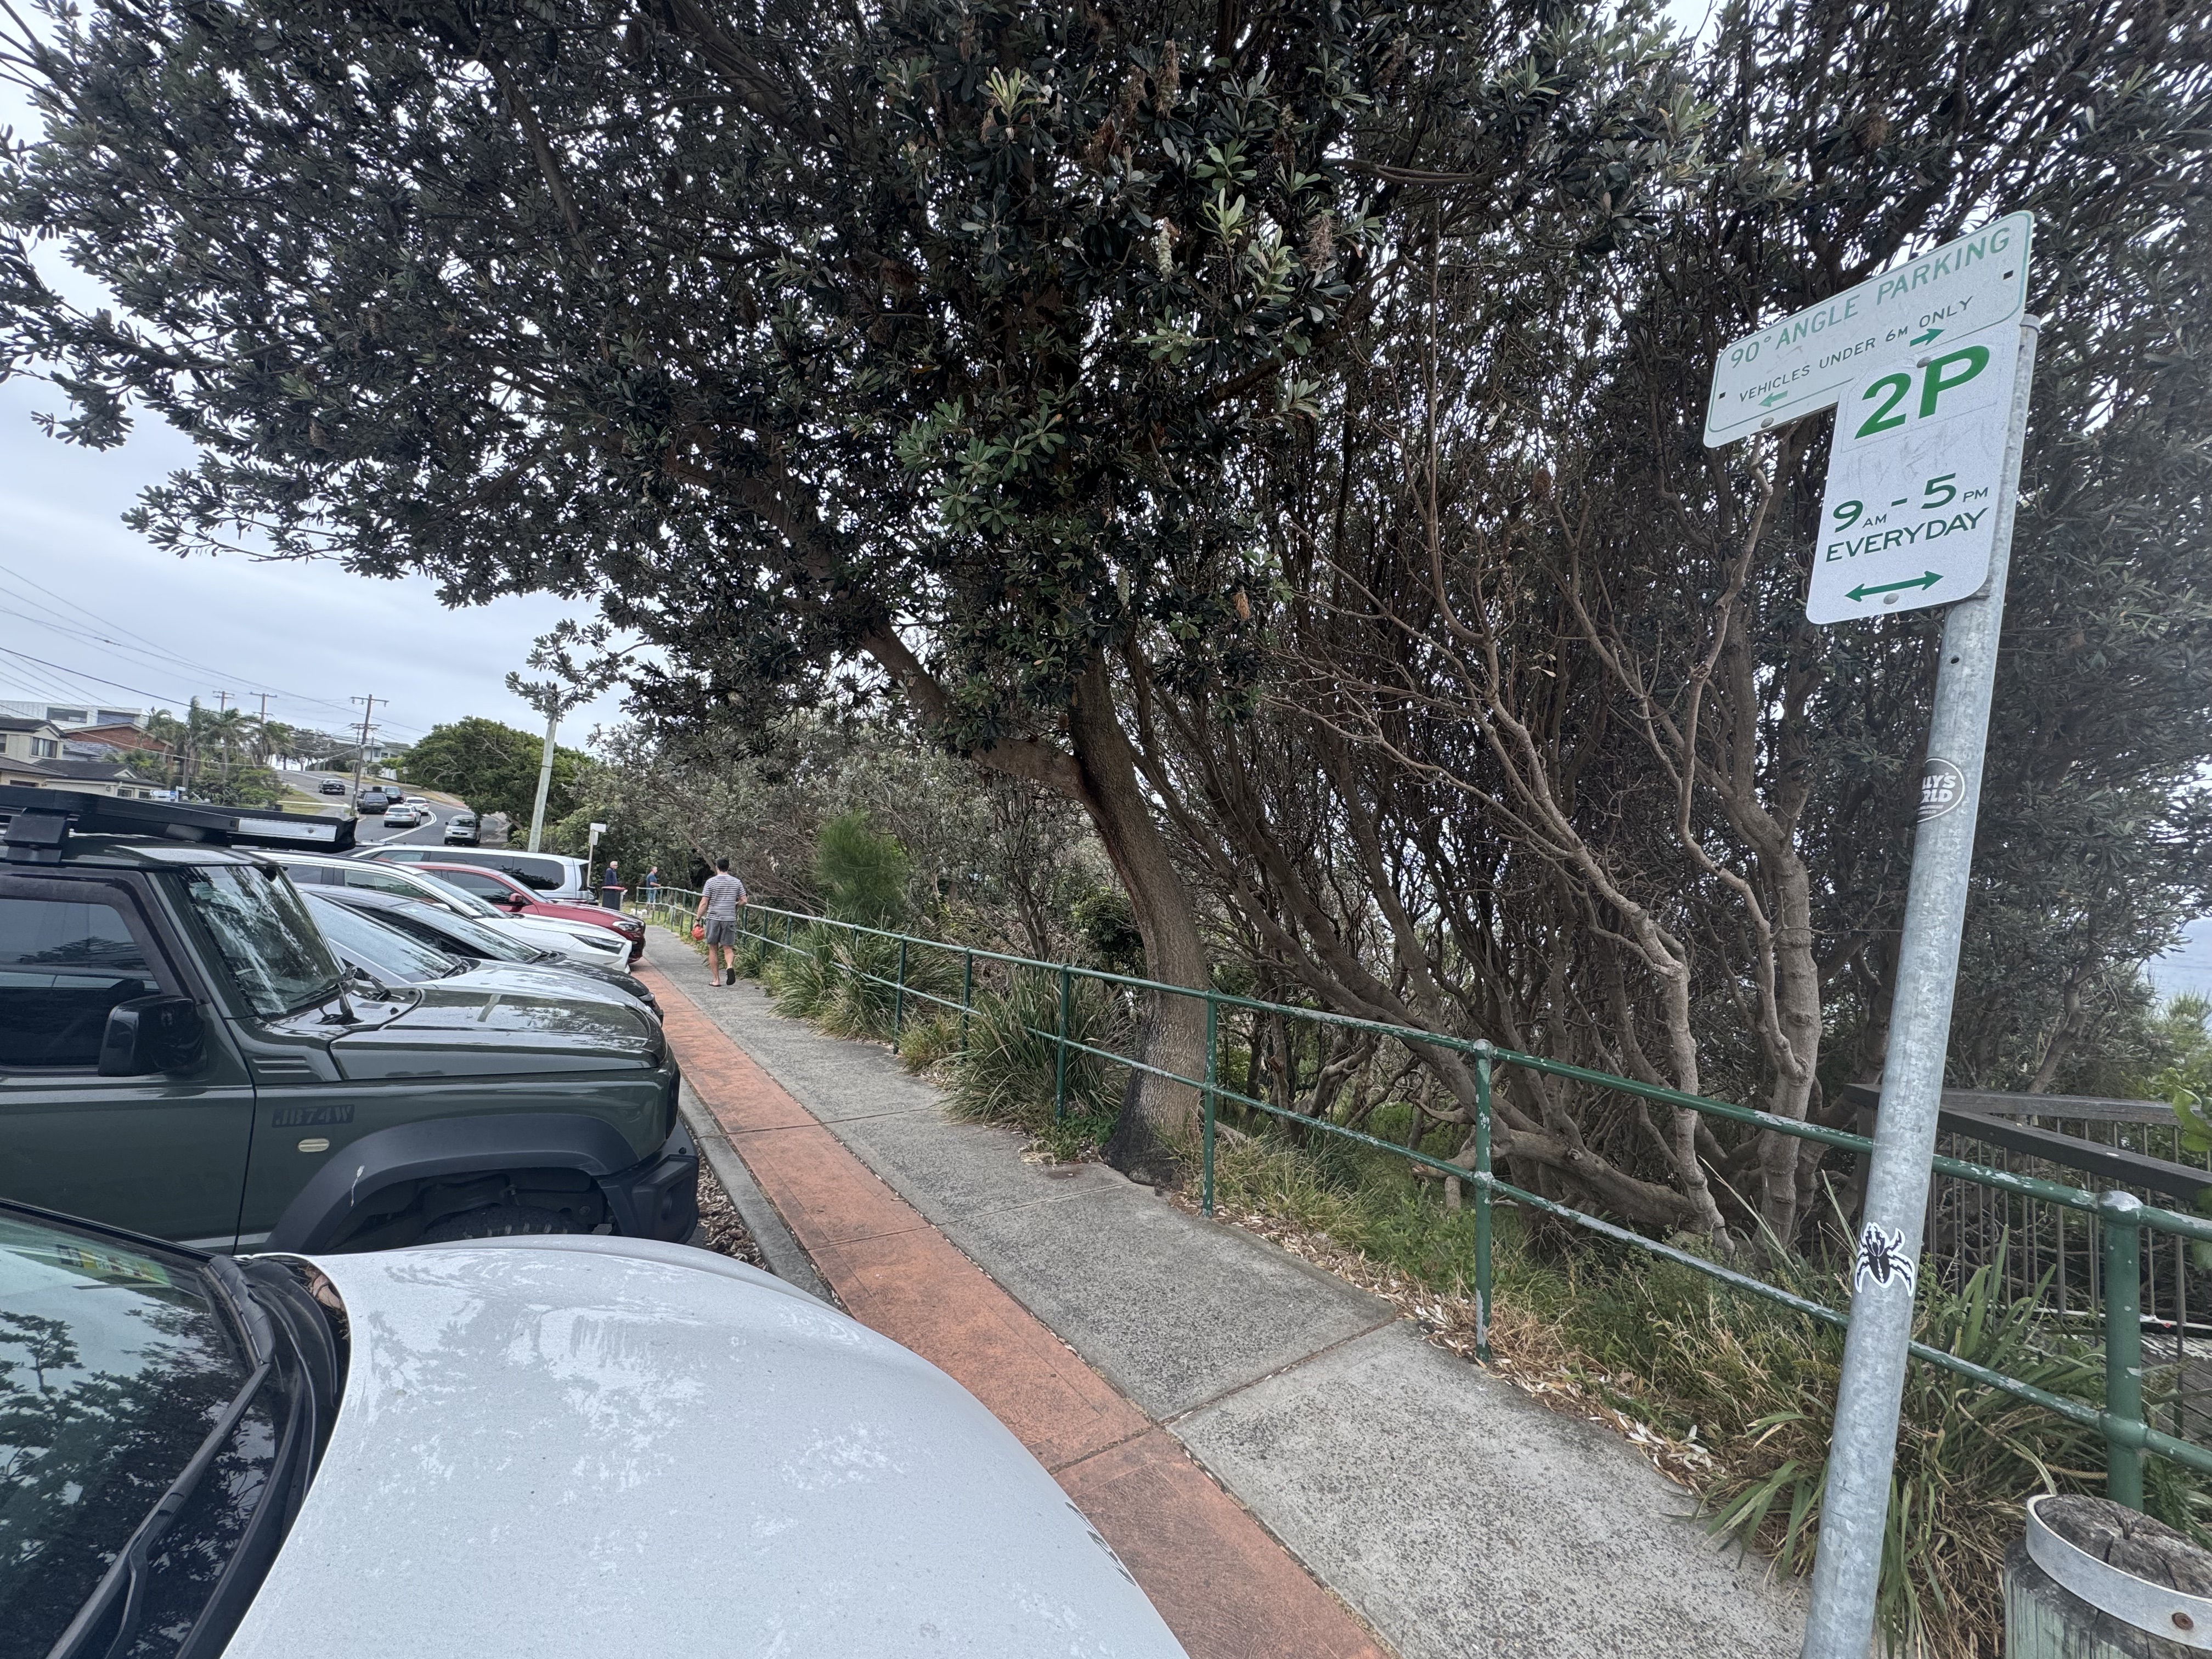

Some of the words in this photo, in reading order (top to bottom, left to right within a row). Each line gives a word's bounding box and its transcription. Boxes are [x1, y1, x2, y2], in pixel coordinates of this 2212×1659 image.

[1775, 294, 1860, 350] ANGLE
[1876, 227, 2010, 306] PARKING
[1739, 365, 1810, 402] VEHICLES
[1819, 338, 1876, 369] UNDER
[1885, 326, 1908, 342] 6M
[1919, 295, 1974, 329] ONLY
[1854, 345, 1990, 439] 2P
[1825, 507, 1990, 562] EVERYDAY
